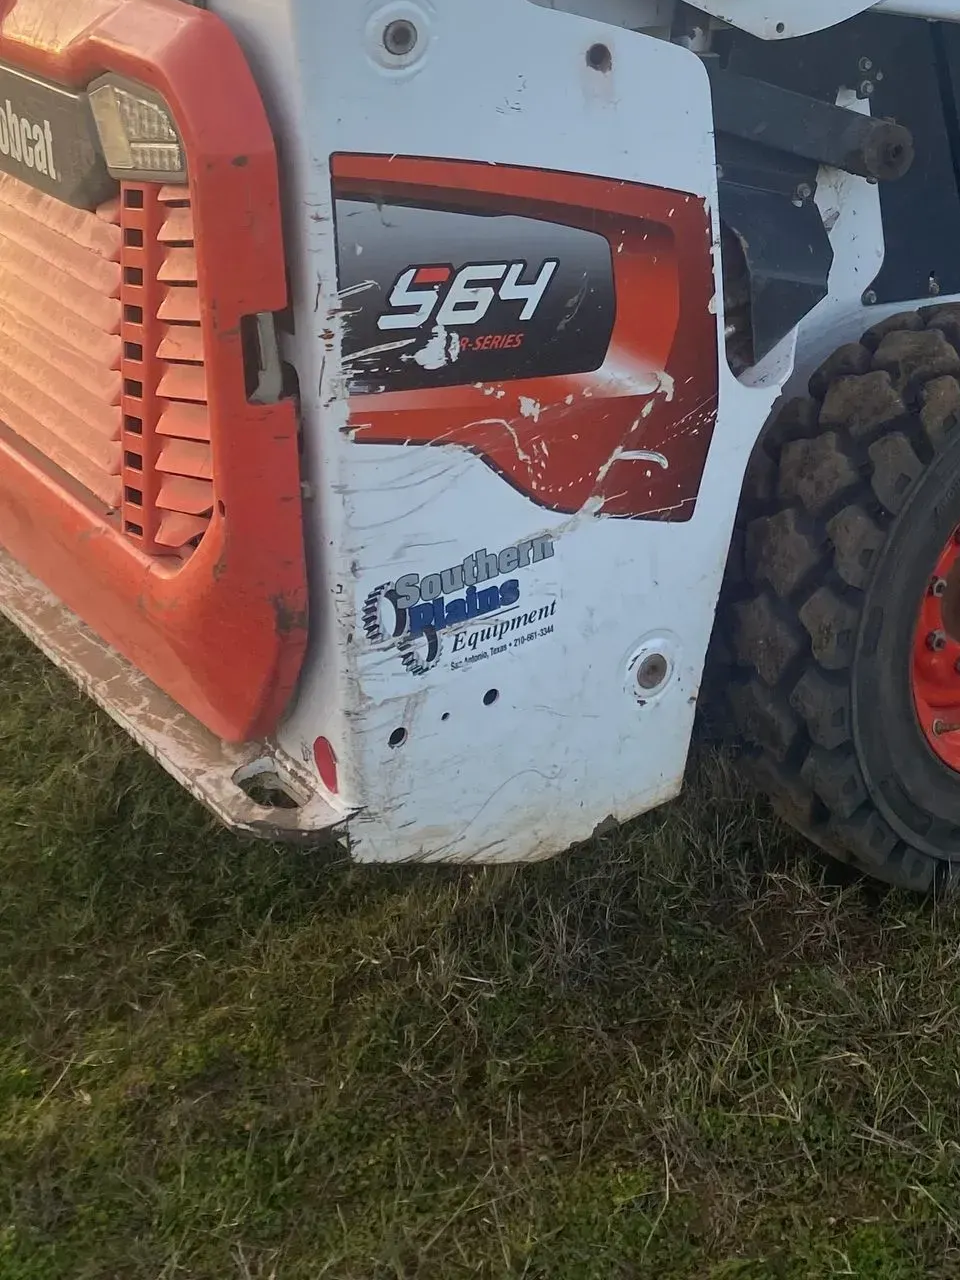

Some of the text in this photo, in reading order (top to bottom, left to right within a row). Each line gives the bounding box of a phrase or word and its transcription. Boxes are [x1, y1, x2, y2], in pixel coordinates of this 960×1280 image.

[0, 99, 57, 180] obcat
[377, 262, 557, 330] S64
[460, 333, 524, 352] R-SERIES
[395, 534, 555, 609] Southern
[408, 579, 520, 639] Plains
[451, 599, 557, 653] Equipment
[490, 643, 507, 656] Texas
